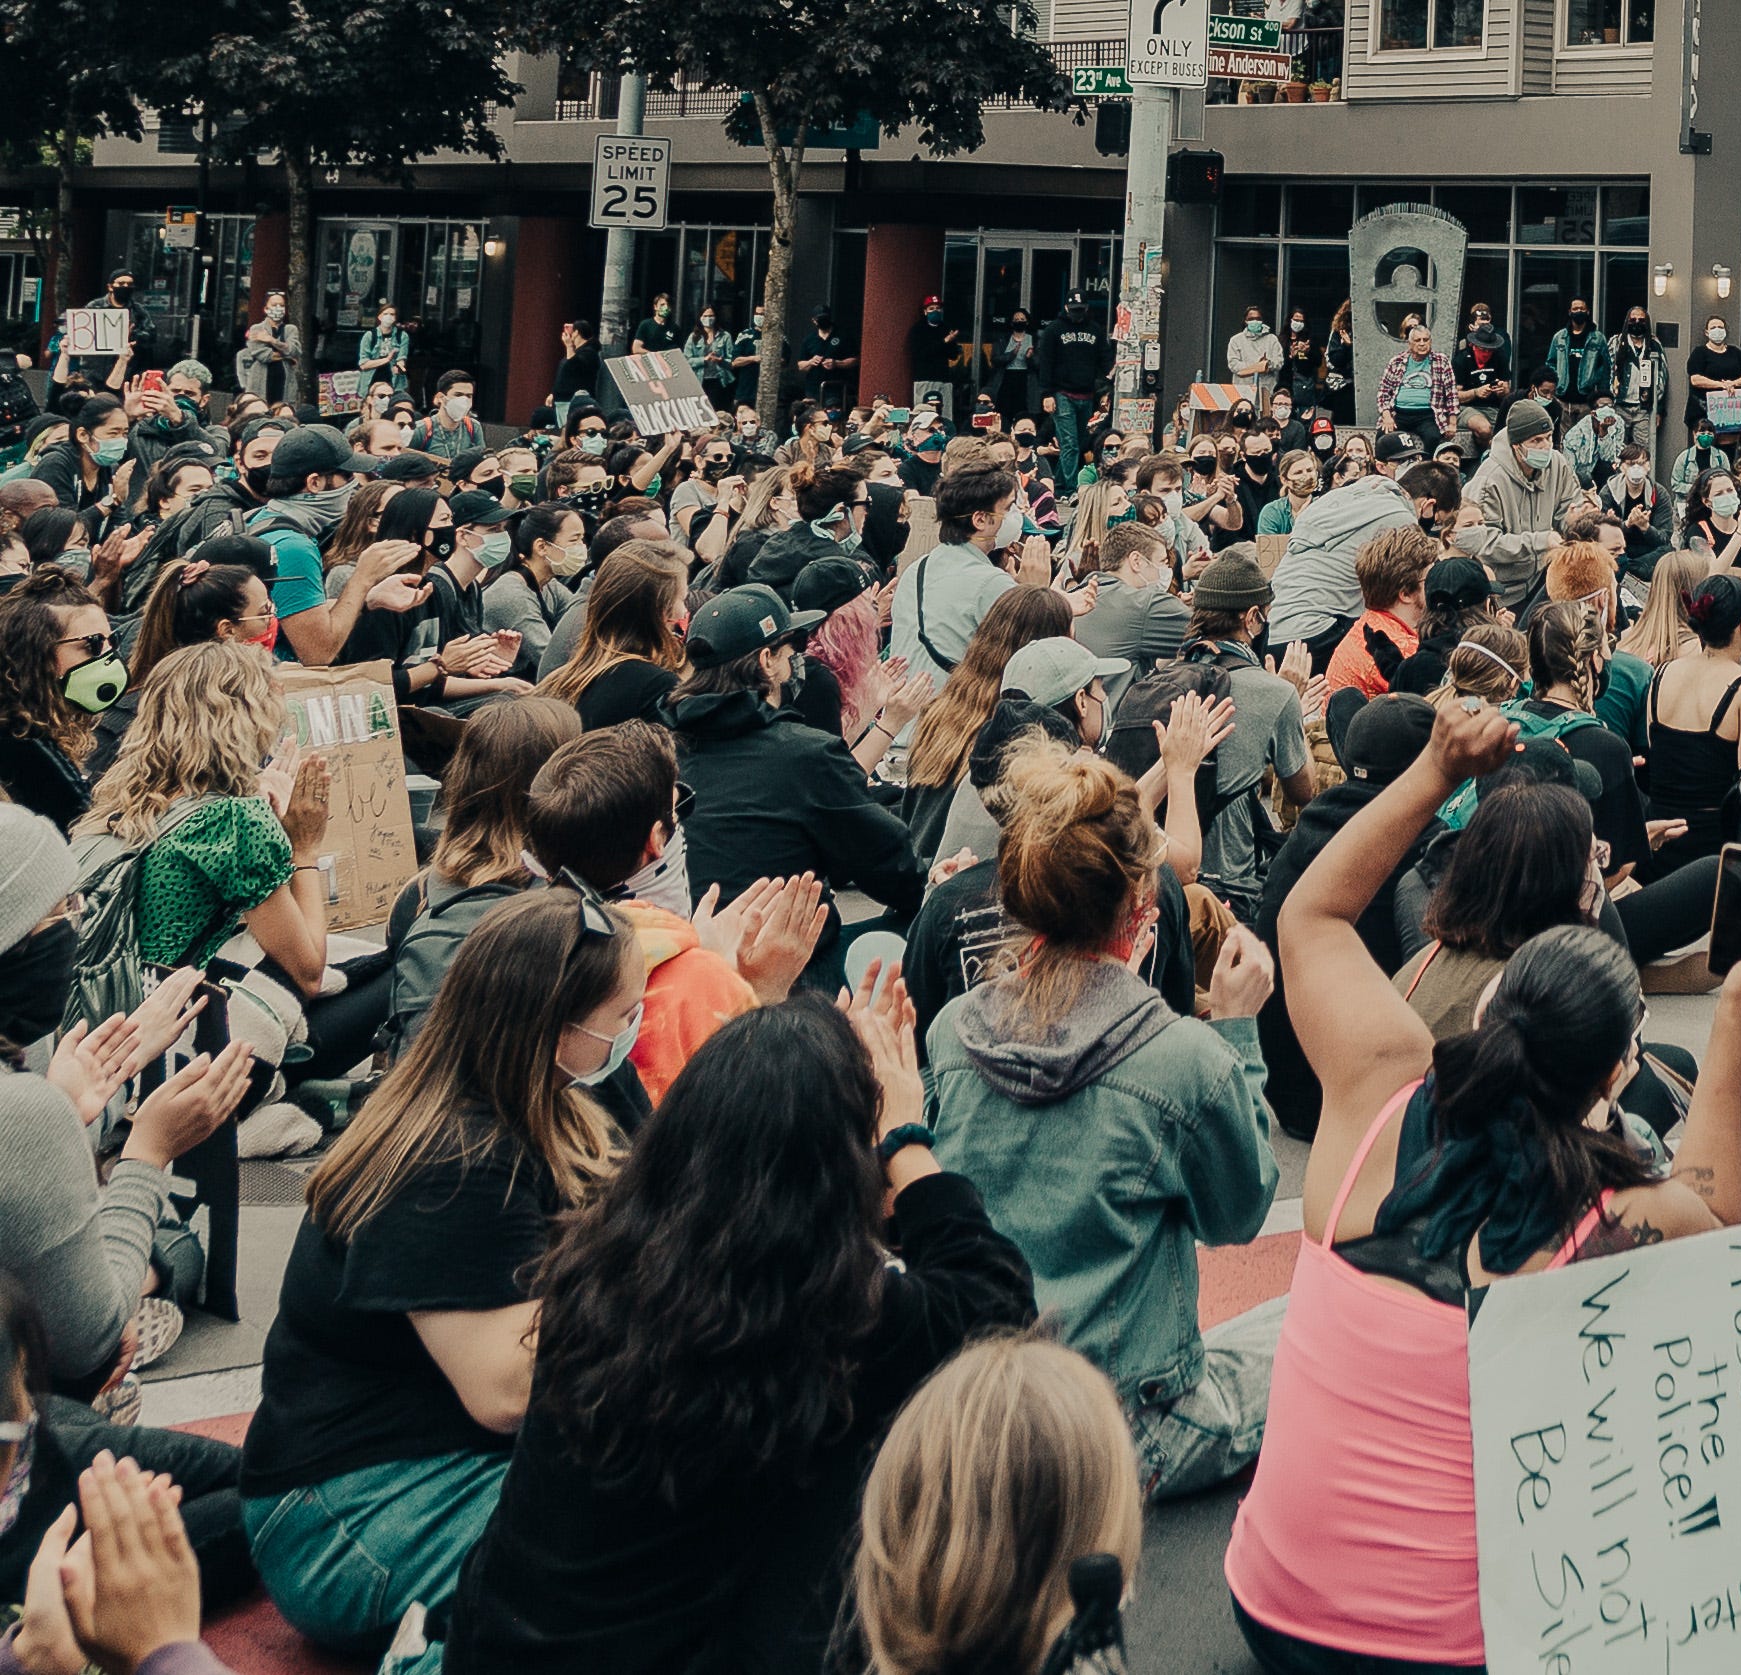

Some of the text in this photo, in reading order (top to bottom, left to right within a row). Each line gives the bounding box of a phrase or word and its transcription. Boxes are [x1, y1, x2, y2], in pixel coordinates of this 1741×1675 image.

[1209, 21, 1279, 42] ckson St 400
[1147, 38, 1192, 58] ONLY
[1130, 60, 1204, 77] EXCEPT BUSES
[1227, 54, 1277, 75] Anderson
[1075, 67, 1121, 91] 23rd Ave
[603, 145, 664, 162] SPEED
[608, 165, 656, 180] LIMIT
[601, 184, 658, 219] 25
[72, 311, 124, 351] BLM
[1698, 1353, 1728, 1465] the
[1579, 1268, 1656, 1647] We will not
[1510, 1422, 1594, 1675] Be Sile
